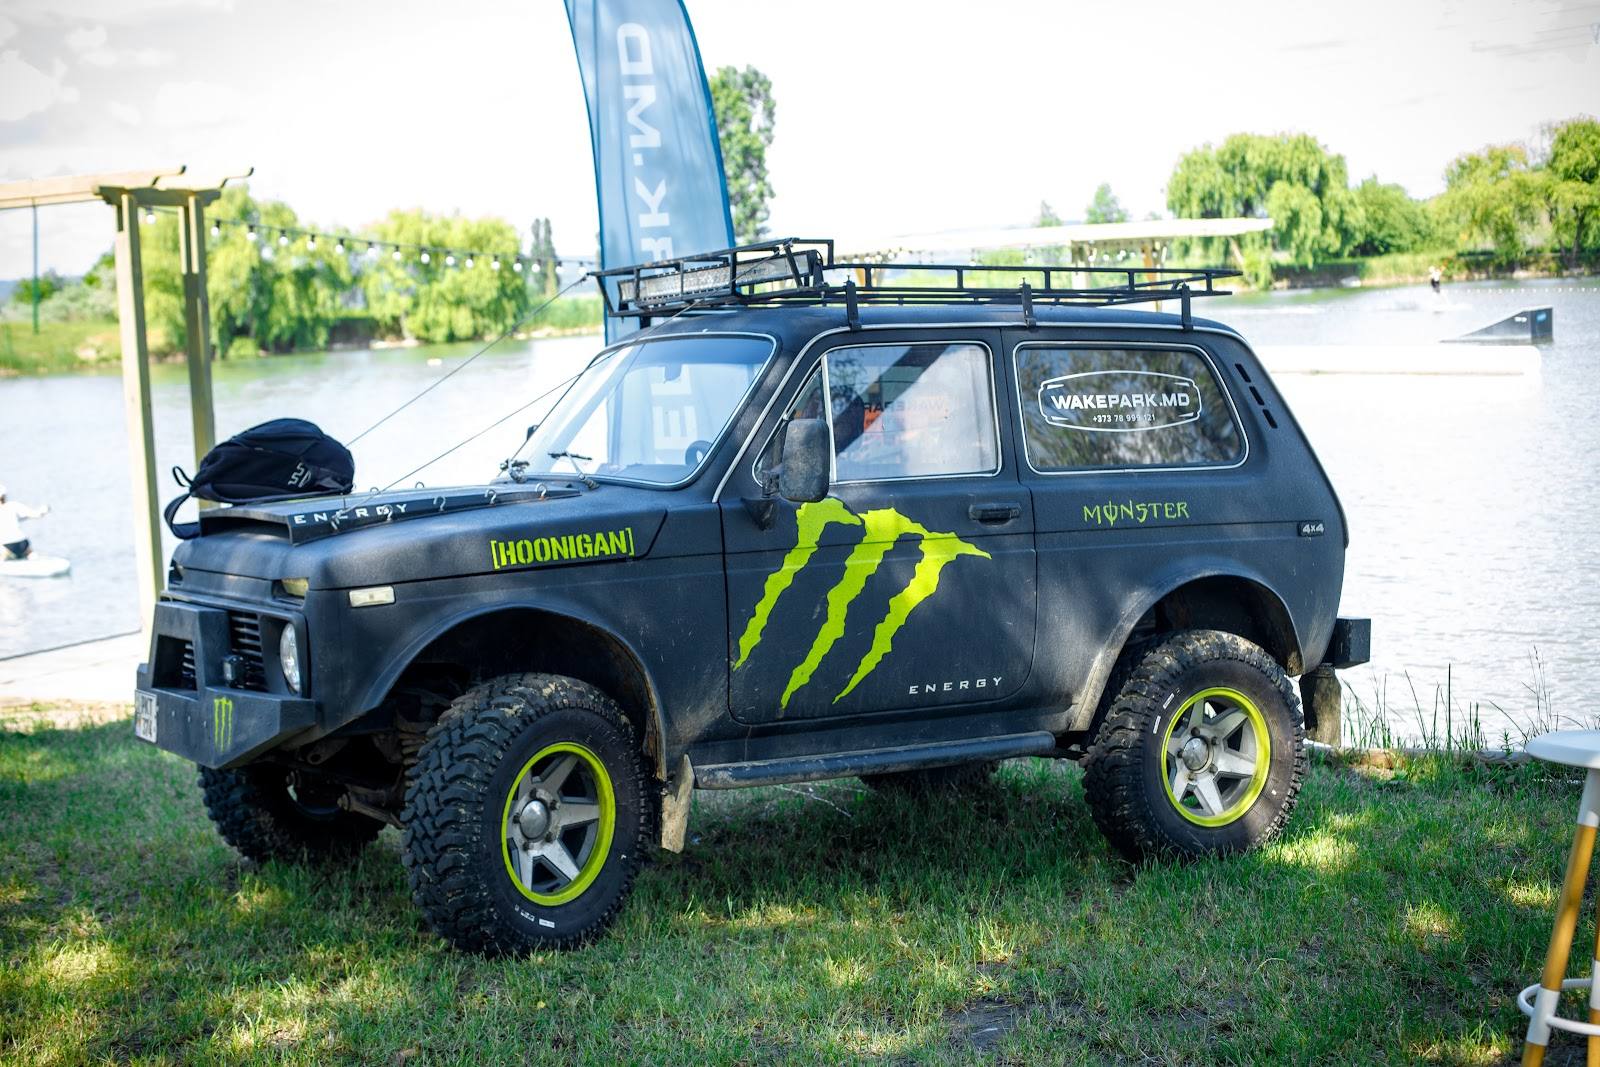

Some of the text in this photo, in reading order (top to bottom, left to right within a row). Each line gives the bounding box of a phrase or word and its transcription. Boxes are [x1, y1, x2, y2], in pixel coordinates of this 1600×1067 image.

[1051, 393, 1190, 410] WAKEPARK.MD
[1093, 414, 1112, 423] +373
[1083, 499, 1190, 527] MONSTER
[908, 676, 1003, 695] ENERGY
